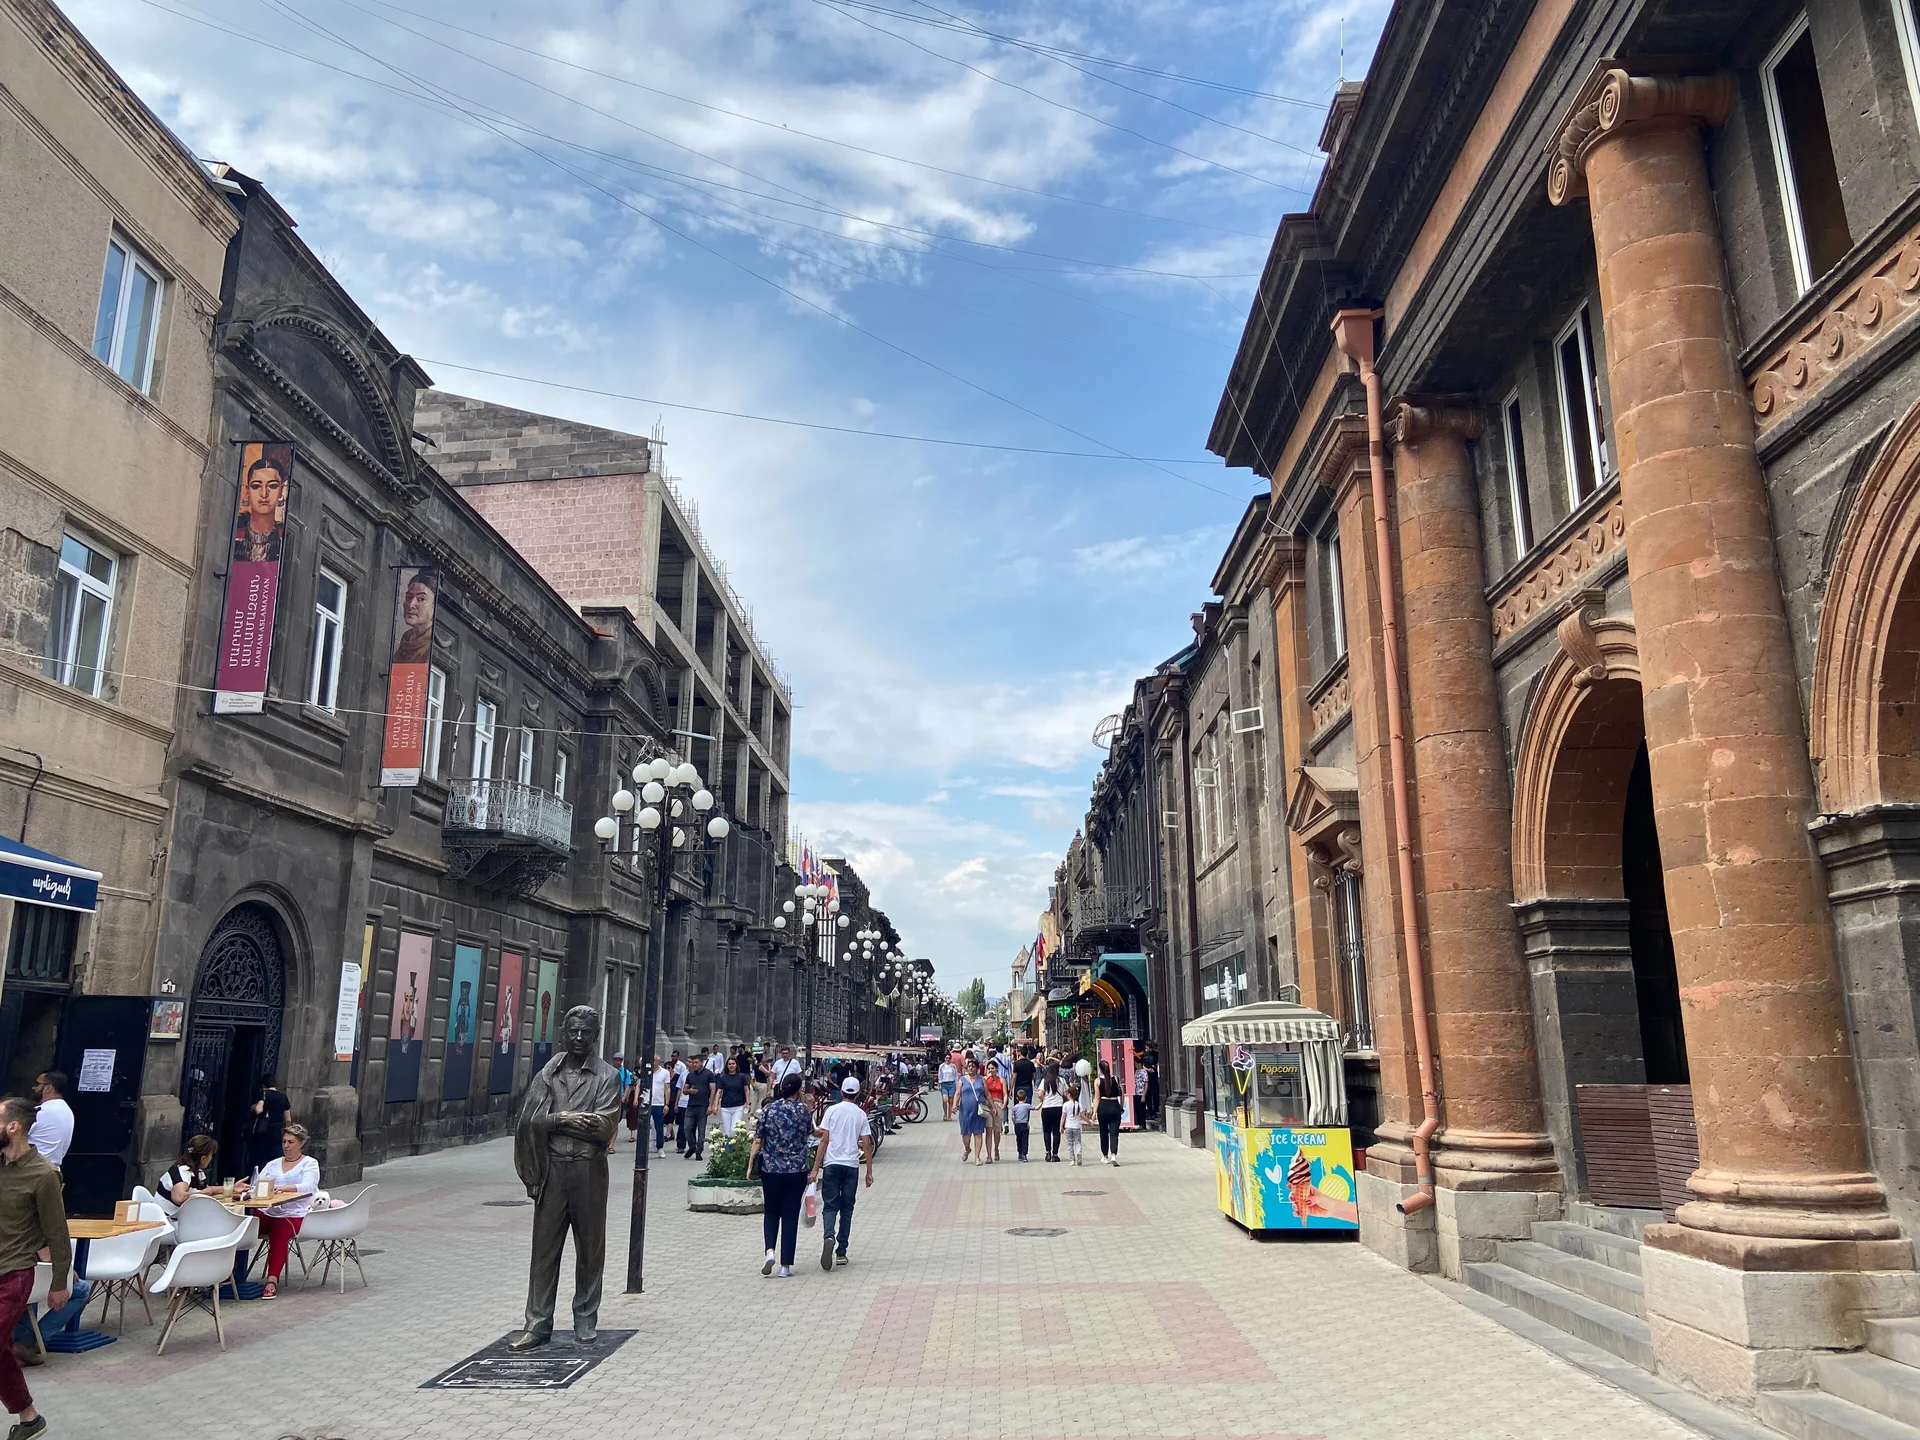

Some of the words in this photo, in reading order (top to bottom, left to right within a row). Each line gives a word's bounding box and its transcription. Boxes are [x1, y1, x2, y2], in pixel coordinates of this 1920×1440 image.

[241, 574, 260, 667] ԱՍԼԱՄԱԶՅԱՆ
[259, 578, 270, 632] ASLAMAZYAN
[229, 610, 244, 667] ՄԱՐԻԱՄ
[255, 634, 264, 667] MARIAM
[1261, 1064, 1297, 1073] Popcorn
[1270, 1134, 1288, 1145] ICE
[1290, 1134, 1325, 1145] CREAM
